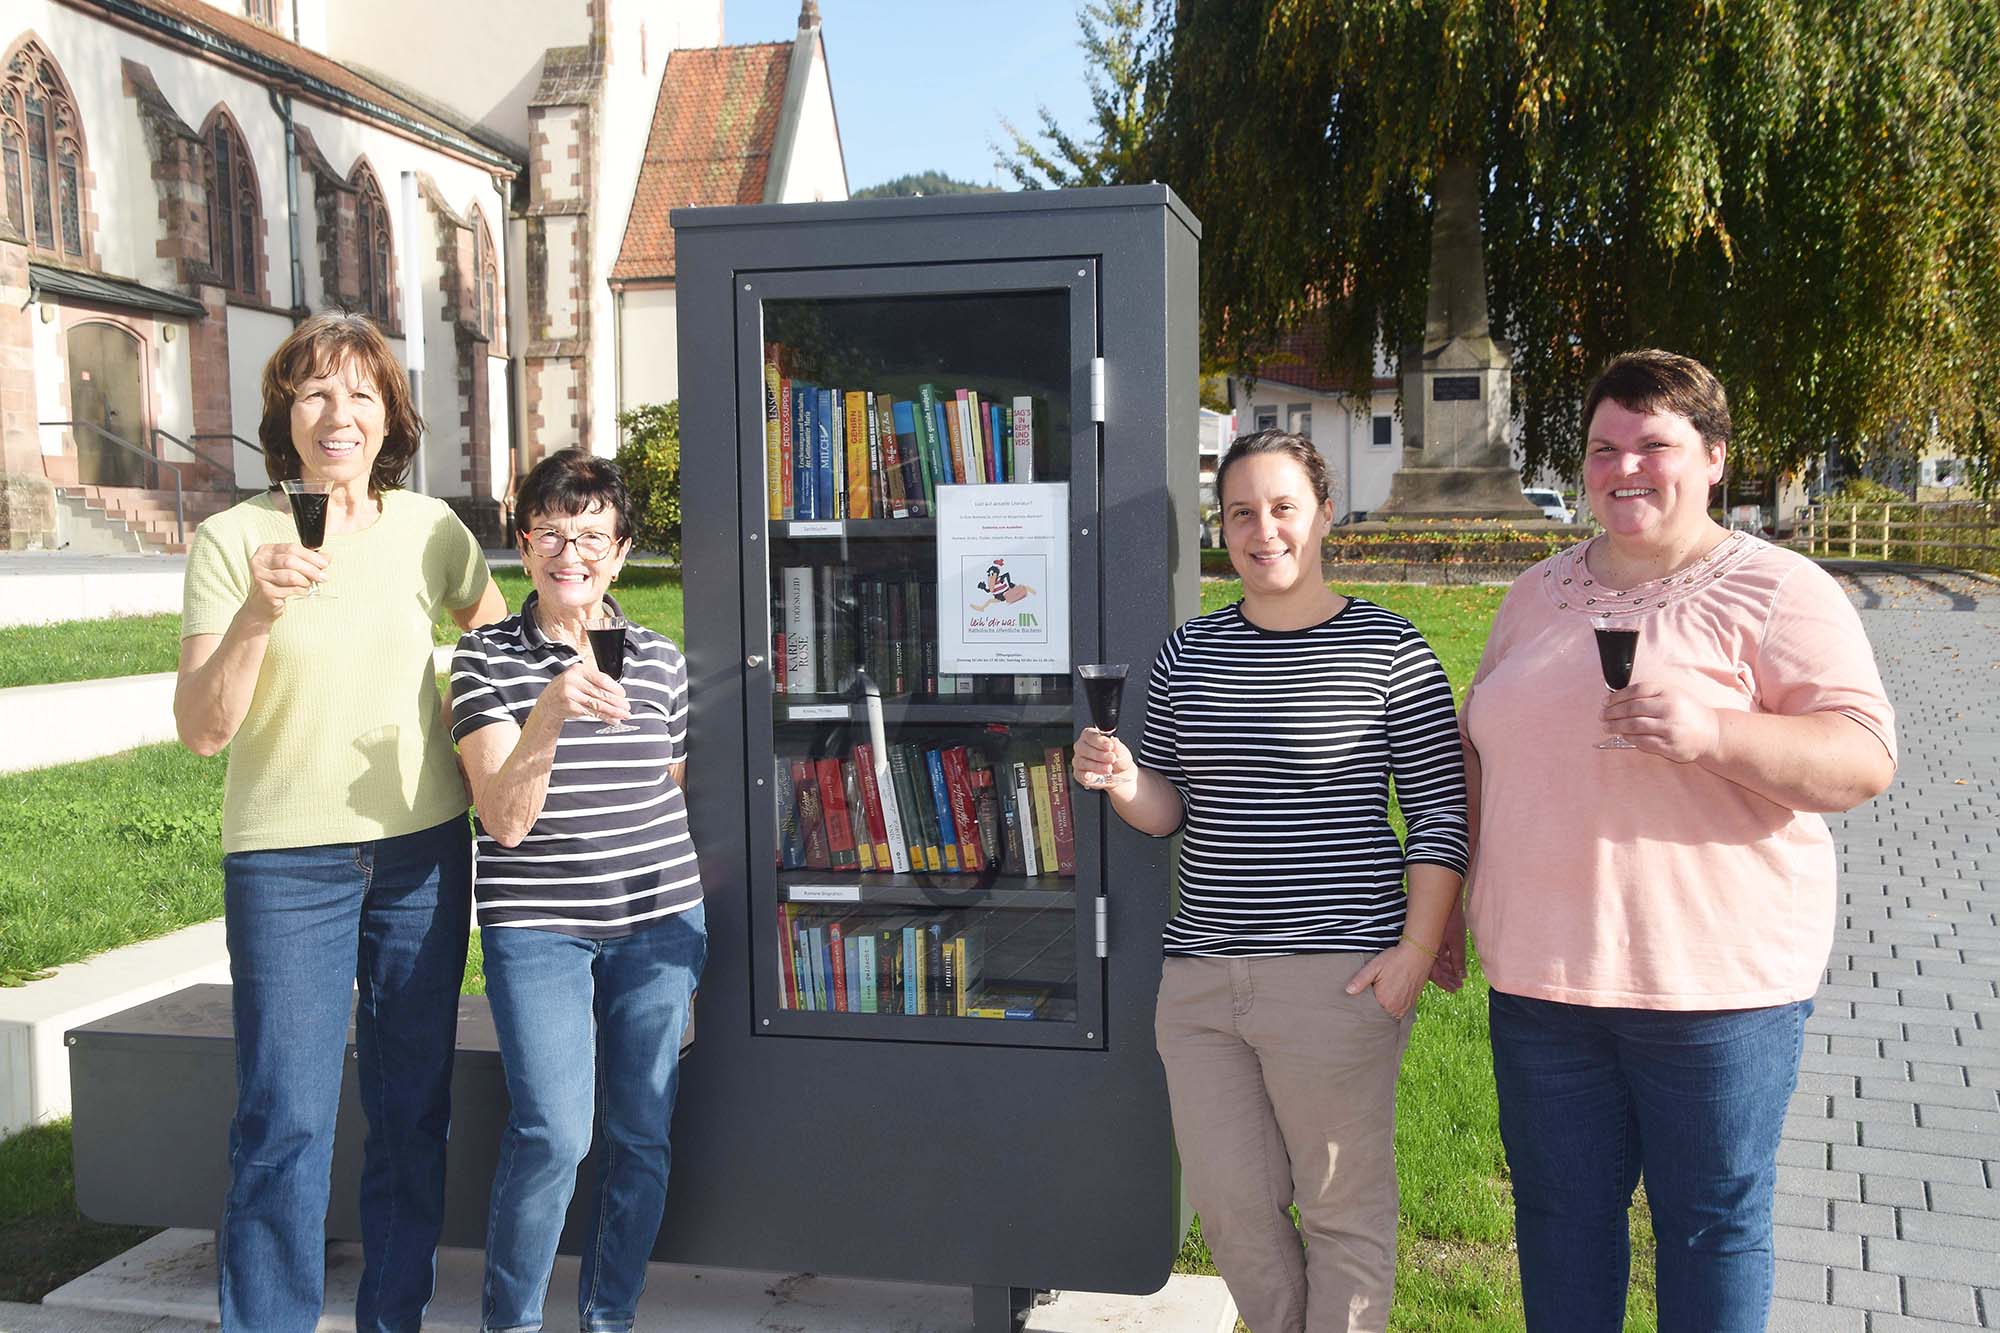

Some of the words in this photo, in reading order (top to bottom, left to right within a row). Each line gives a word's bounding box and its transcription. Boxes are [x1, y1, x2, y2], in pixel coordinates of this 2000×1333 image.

[783, 386, 791, 447] DETOX-SUPPEN
[850, 410, 858, 444] GEHIRN
[925, 411, 934, 432] geniale
[820, 435, 830, 469] MILCH
[787, 632, 798, 672] KAREN
[799, 636, 809, 668] ROSE
[1017, 768, 1026, 787] PIPER
